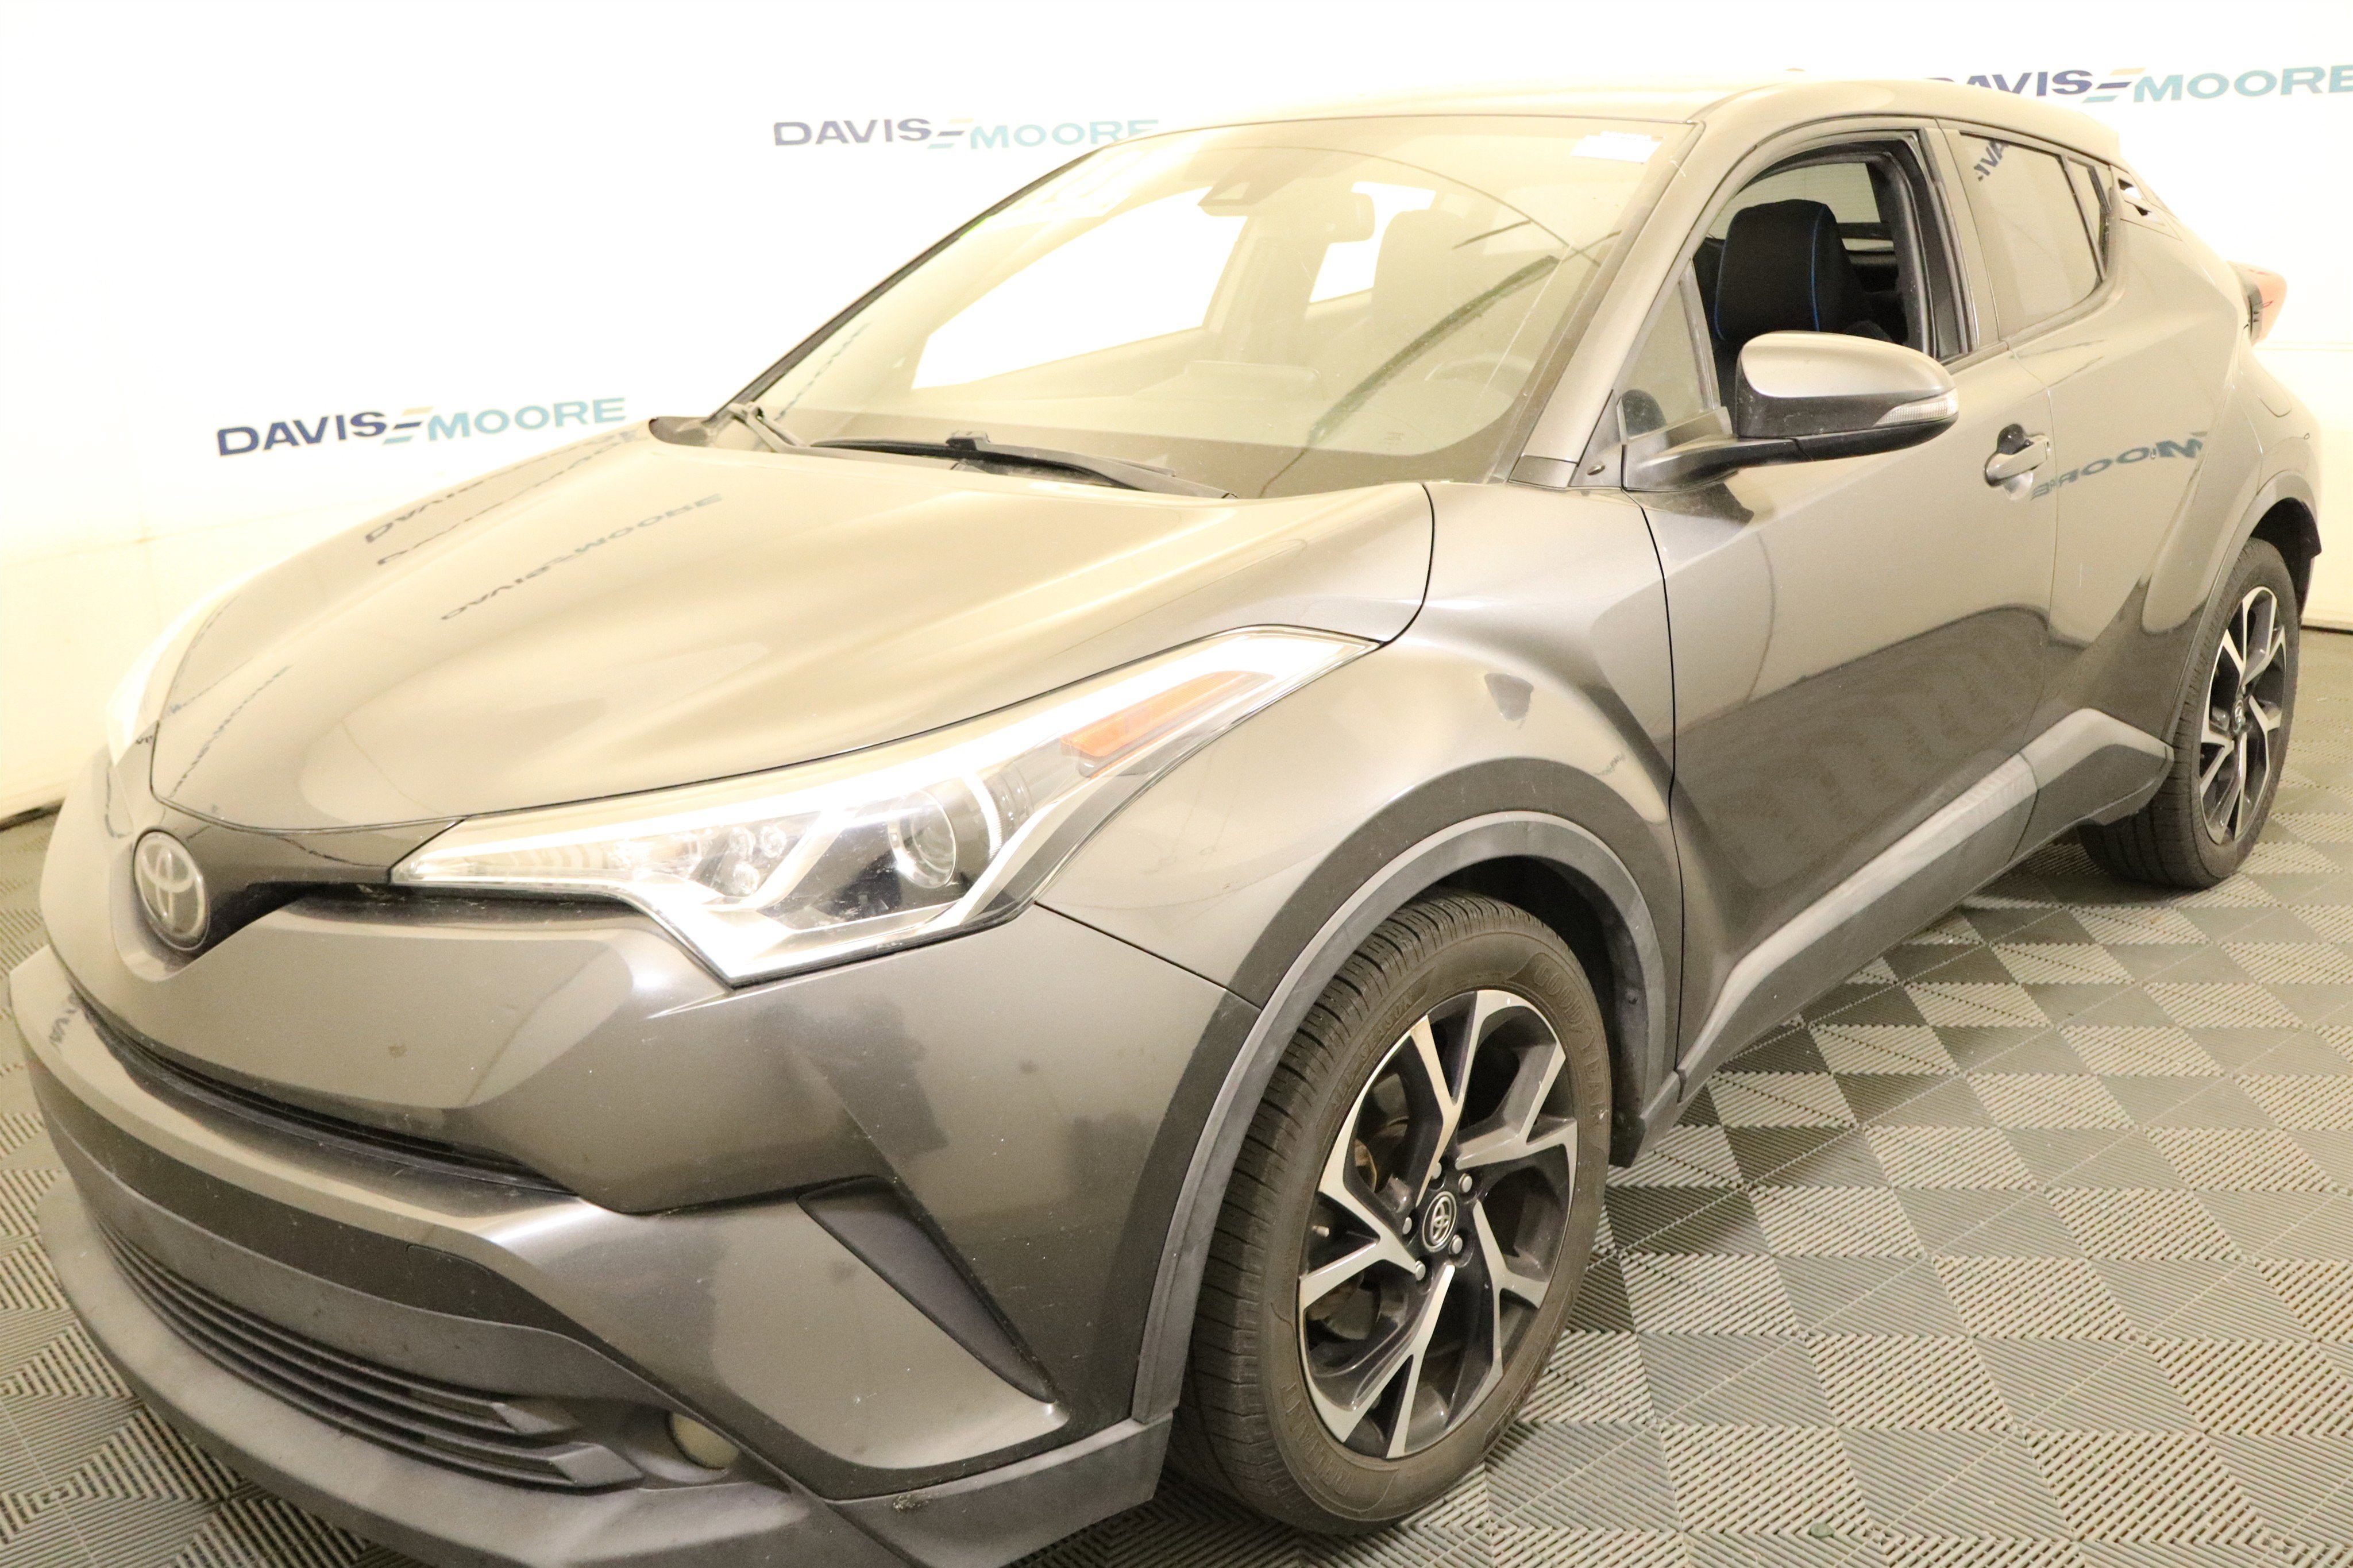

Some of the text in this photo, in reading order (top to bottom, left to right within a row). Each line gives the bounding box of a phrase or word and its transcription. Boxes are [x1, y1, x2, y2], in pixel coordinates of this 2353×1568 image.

[1923, 64, 2353, 103] VIS MOORE
[773, 118, 931, 146] DAVIS
[217, 397, 626, 456] DAVIS MOORE
